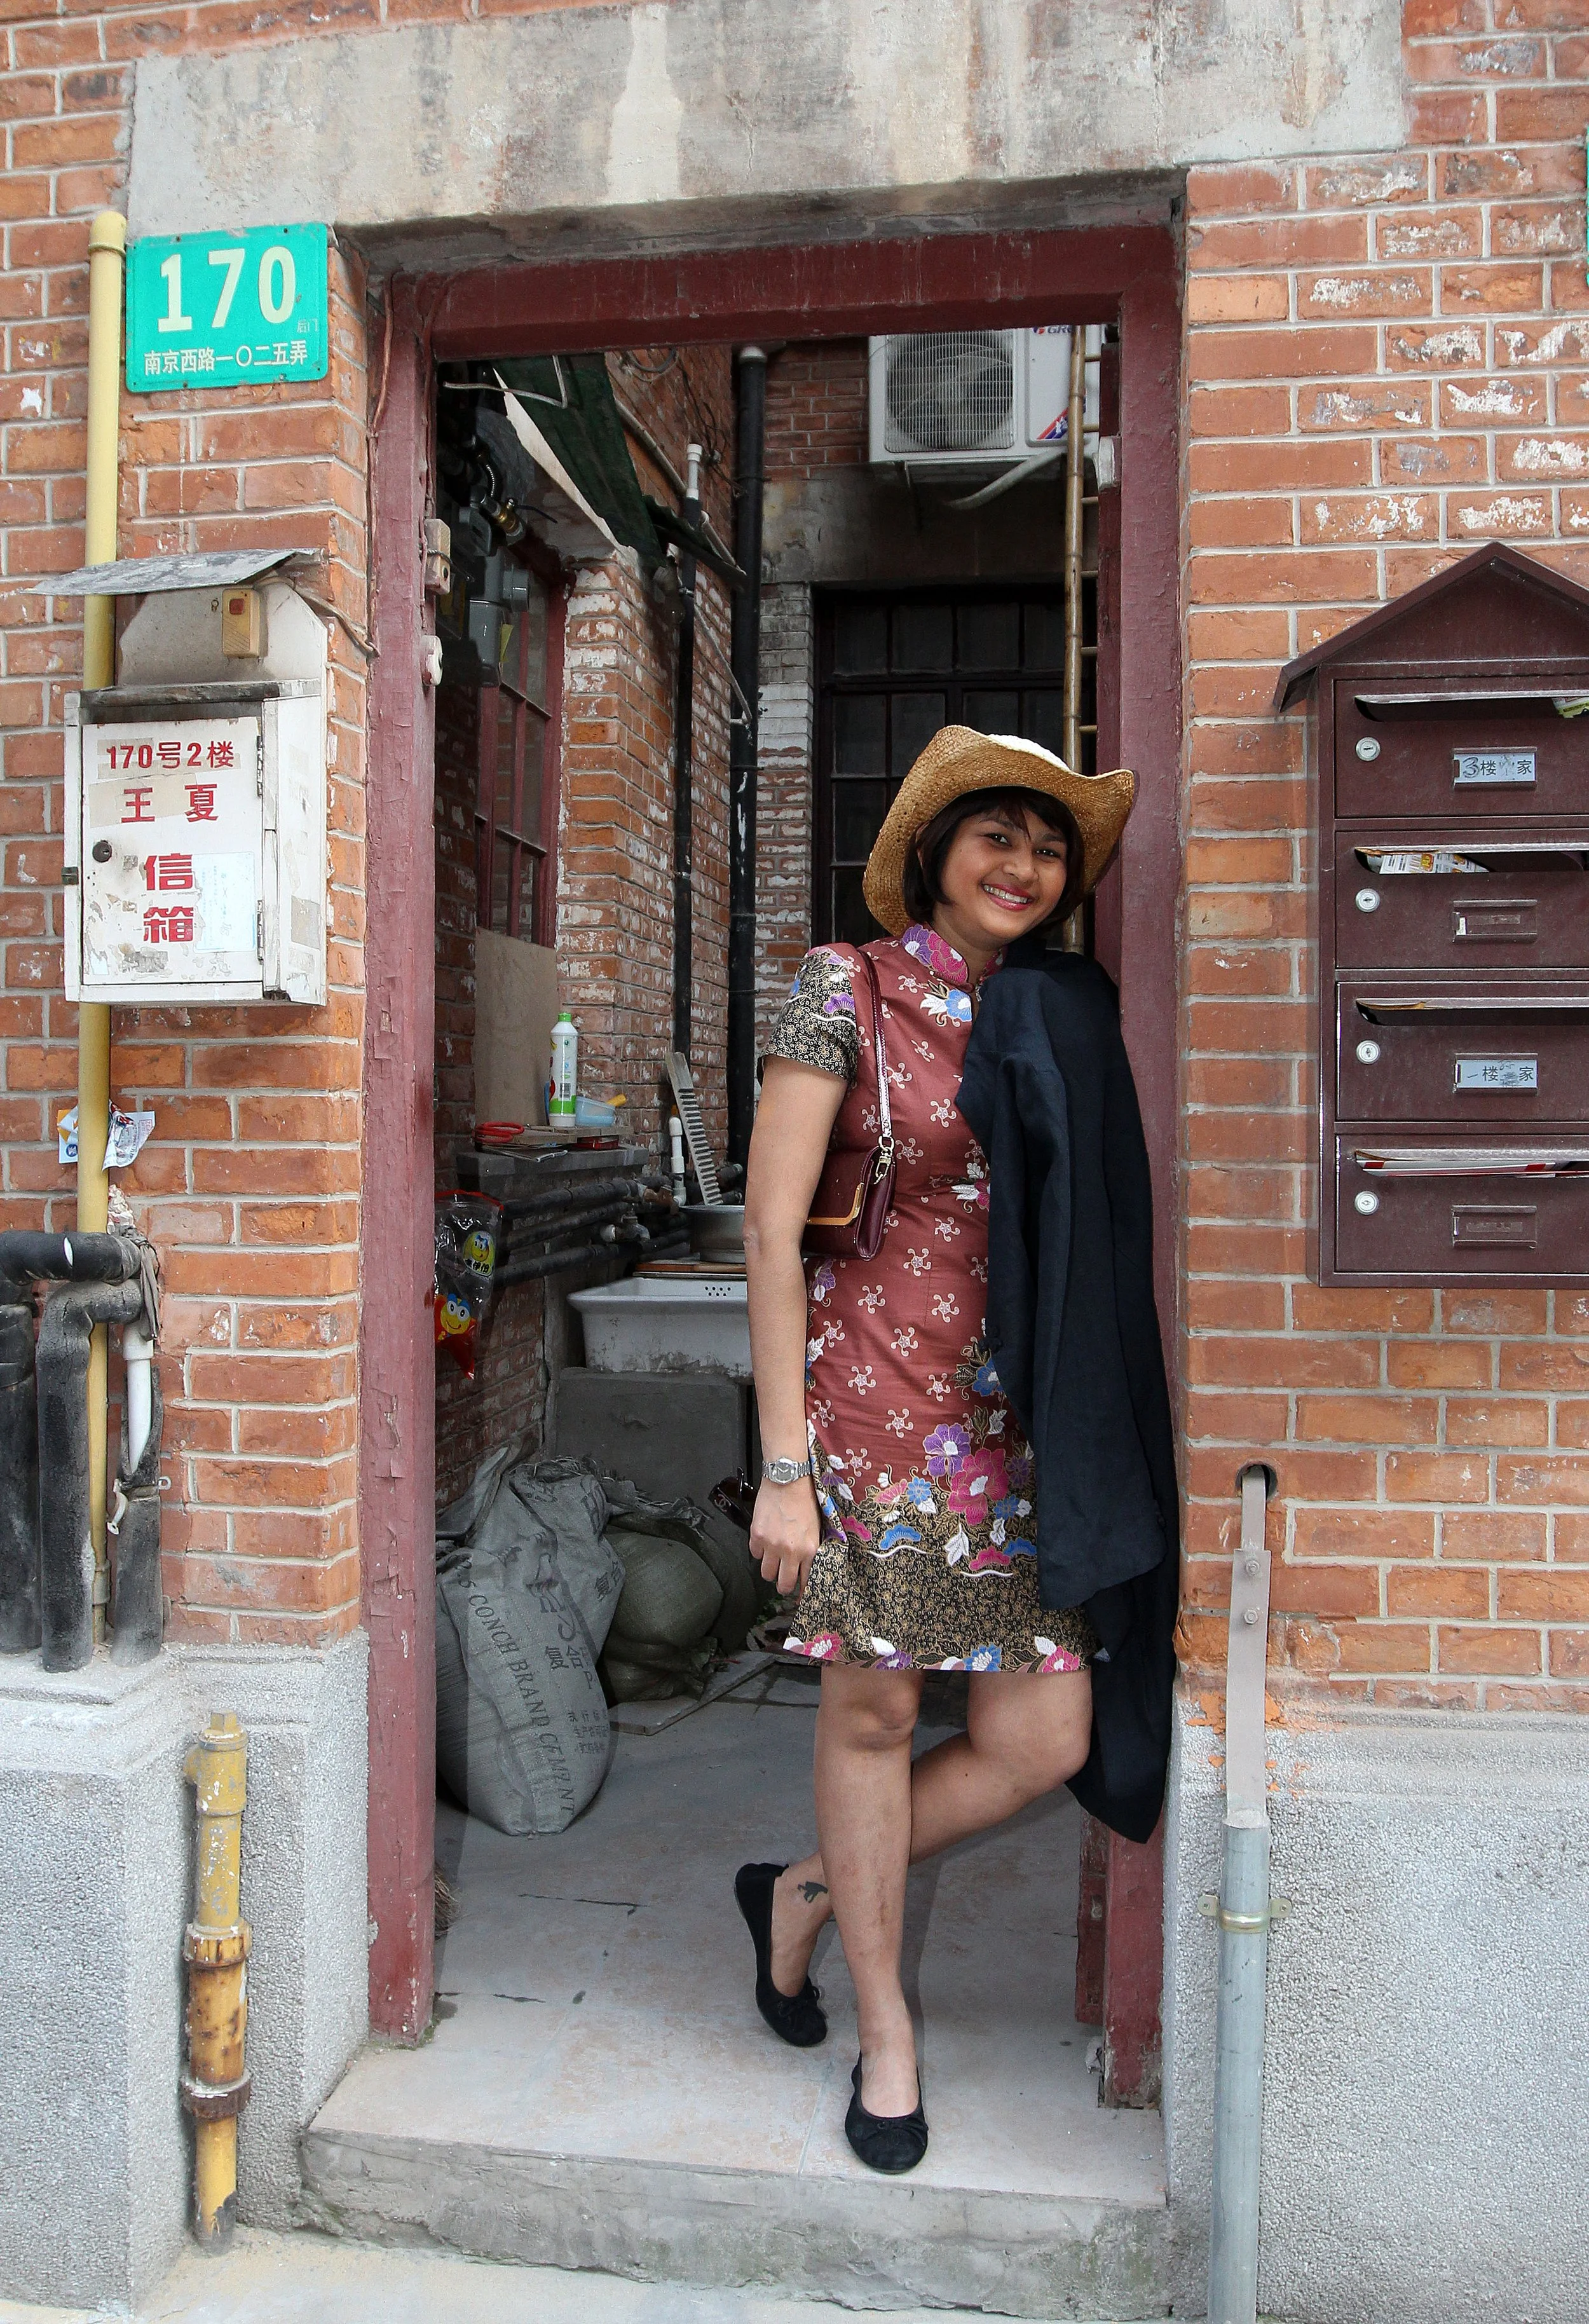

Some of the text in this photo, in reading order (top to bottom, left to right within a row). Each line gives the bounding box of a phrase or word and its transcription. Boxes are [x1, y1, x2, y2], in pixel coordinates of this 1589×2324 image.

[157, 245, 296, 332] 170
[106, 741, 235, 769] 170号2楼
[468, 1594, 519, 1655] CONCH
[508, 1658, 550, 1727] BRAND
